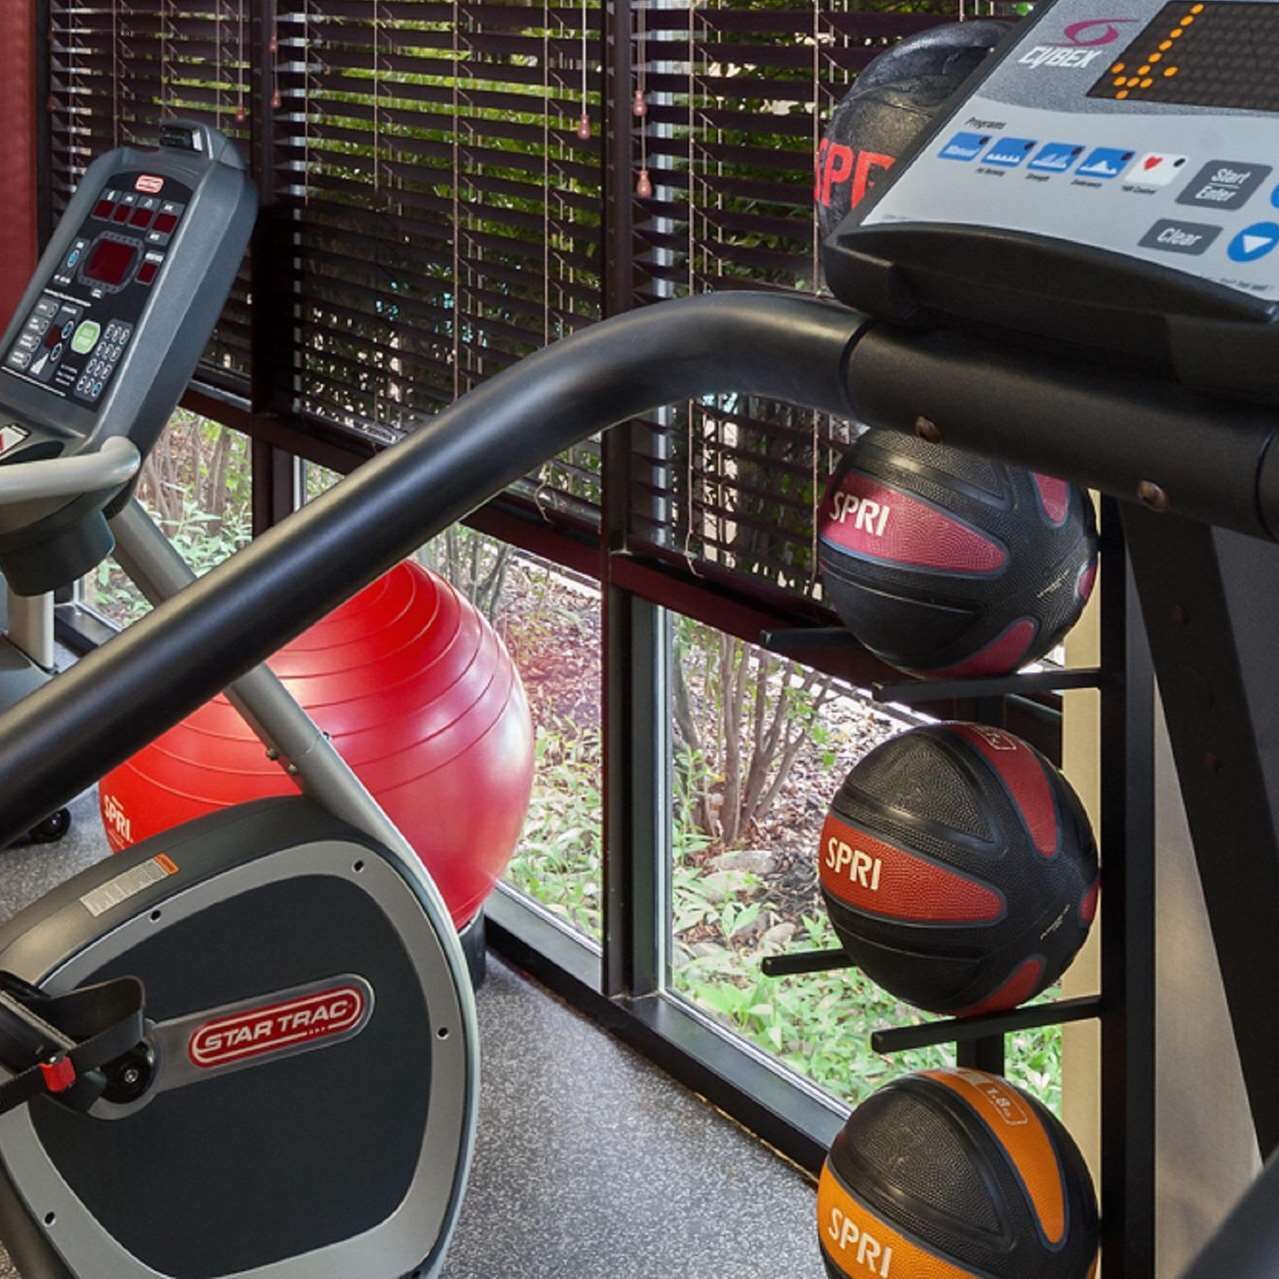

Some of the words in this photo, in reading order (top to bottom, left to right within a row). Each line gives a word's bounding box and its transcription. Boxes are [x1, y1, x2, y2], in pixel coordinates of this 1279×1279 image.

[1018, 46, 1102, 69] CYBEX
[964, 116, 1007, 130] Programs
[1211, 168, 1251, 185] Start
[1195, 186, 1236, 202] Enter
[1156, 227, 1202, 247] Clear
[829, 491, 890, 537] SPRI
[104, 794, 131, 841] SPRI
[825, 837, 882, 891] SPRI
[205, 1020, 274, 1049] STAR
[278, 1000, 349, 1032] TRAC
[828, 1208, 892, 1278] SPRI
